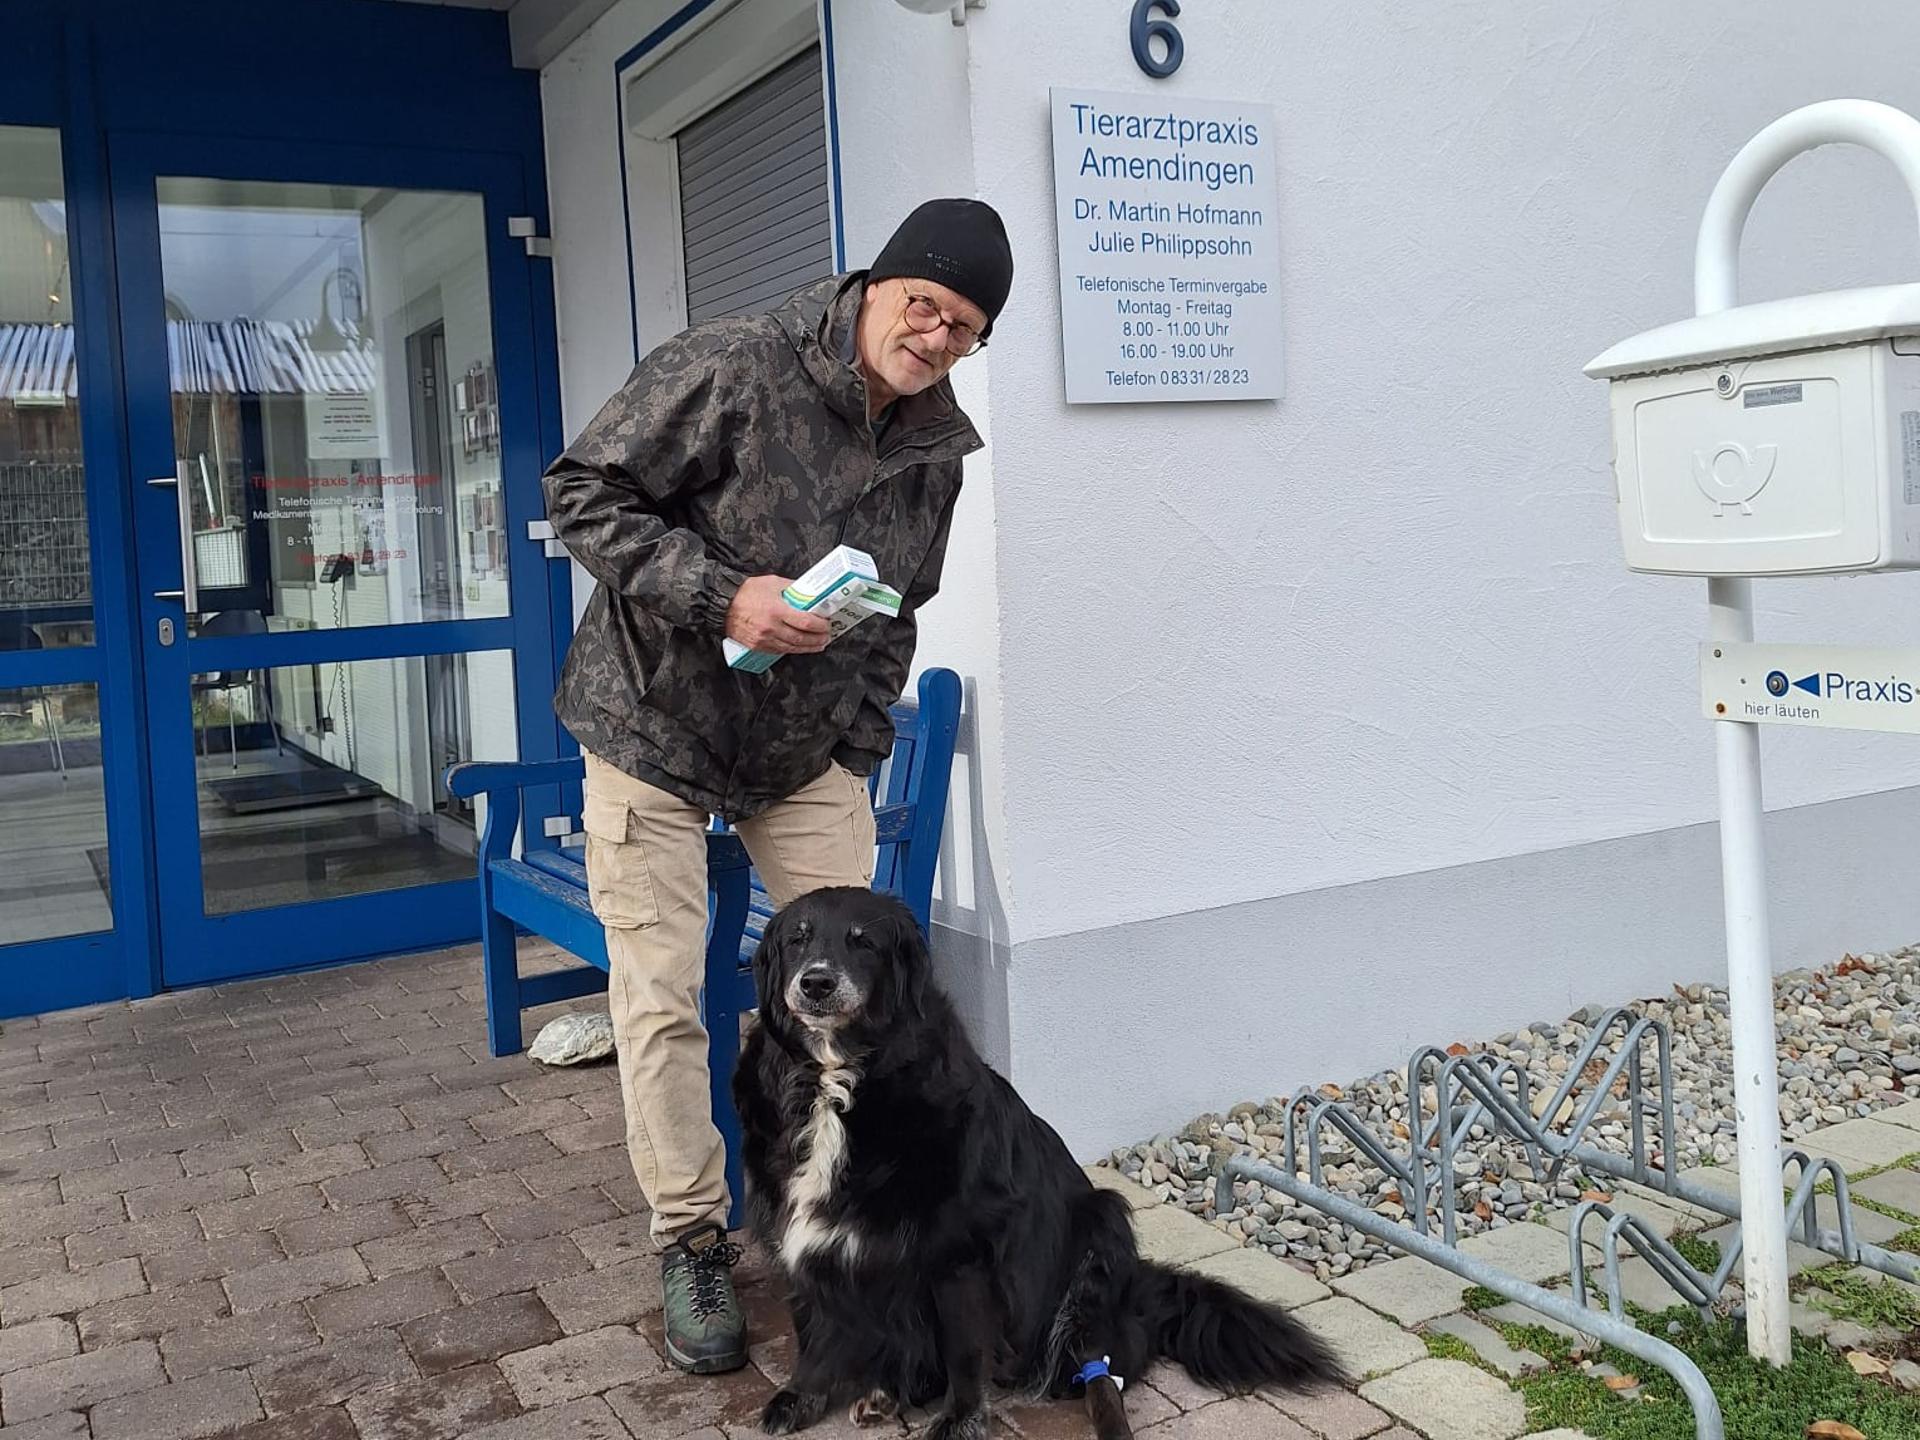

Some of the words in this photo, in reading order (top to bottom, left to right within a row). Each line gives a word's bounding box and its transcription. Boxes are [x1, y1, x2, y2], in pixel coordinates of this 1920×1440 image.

[1130, 0, 1184, 79] 6
[1069, 104, 1259, 149] Tierarztpraxis
[1079, 146, 1255, 191] Amendingen
[1074, 198, 1102, 221] Dr.
[1108, 201, 1172, 224] Martin
[1177, 203, 1263, 227] Hofmann
[1088, 231, 1136, 254] Julie
[1141, 232, 1253, 260] Philippsohn
[1076, 275, 1166, 294] Telefonische
[1168, 277, 1268, 297] Terminvergabe
[1117, 299, 1173, 318] Montag
[1185, 301, 1233, 319] Freitag
[1122, 321, 1154, 337] 8.00
[1167, 321, 1201, 337] 11.00
[1205, 321, 1230, 337] Uhr
[1119, 343, 1158, 359] 16.00
[1171, 343, 1207, 359] 19.00
[1210, 343, 1235, 359] Uhr
[1105, 370, 1157, 386] Telefon
[1825, 672, 1915, 704] Praxis
[1744, 702, 1770, 716] hier
[1774, 703, 1820, 719] läuten
